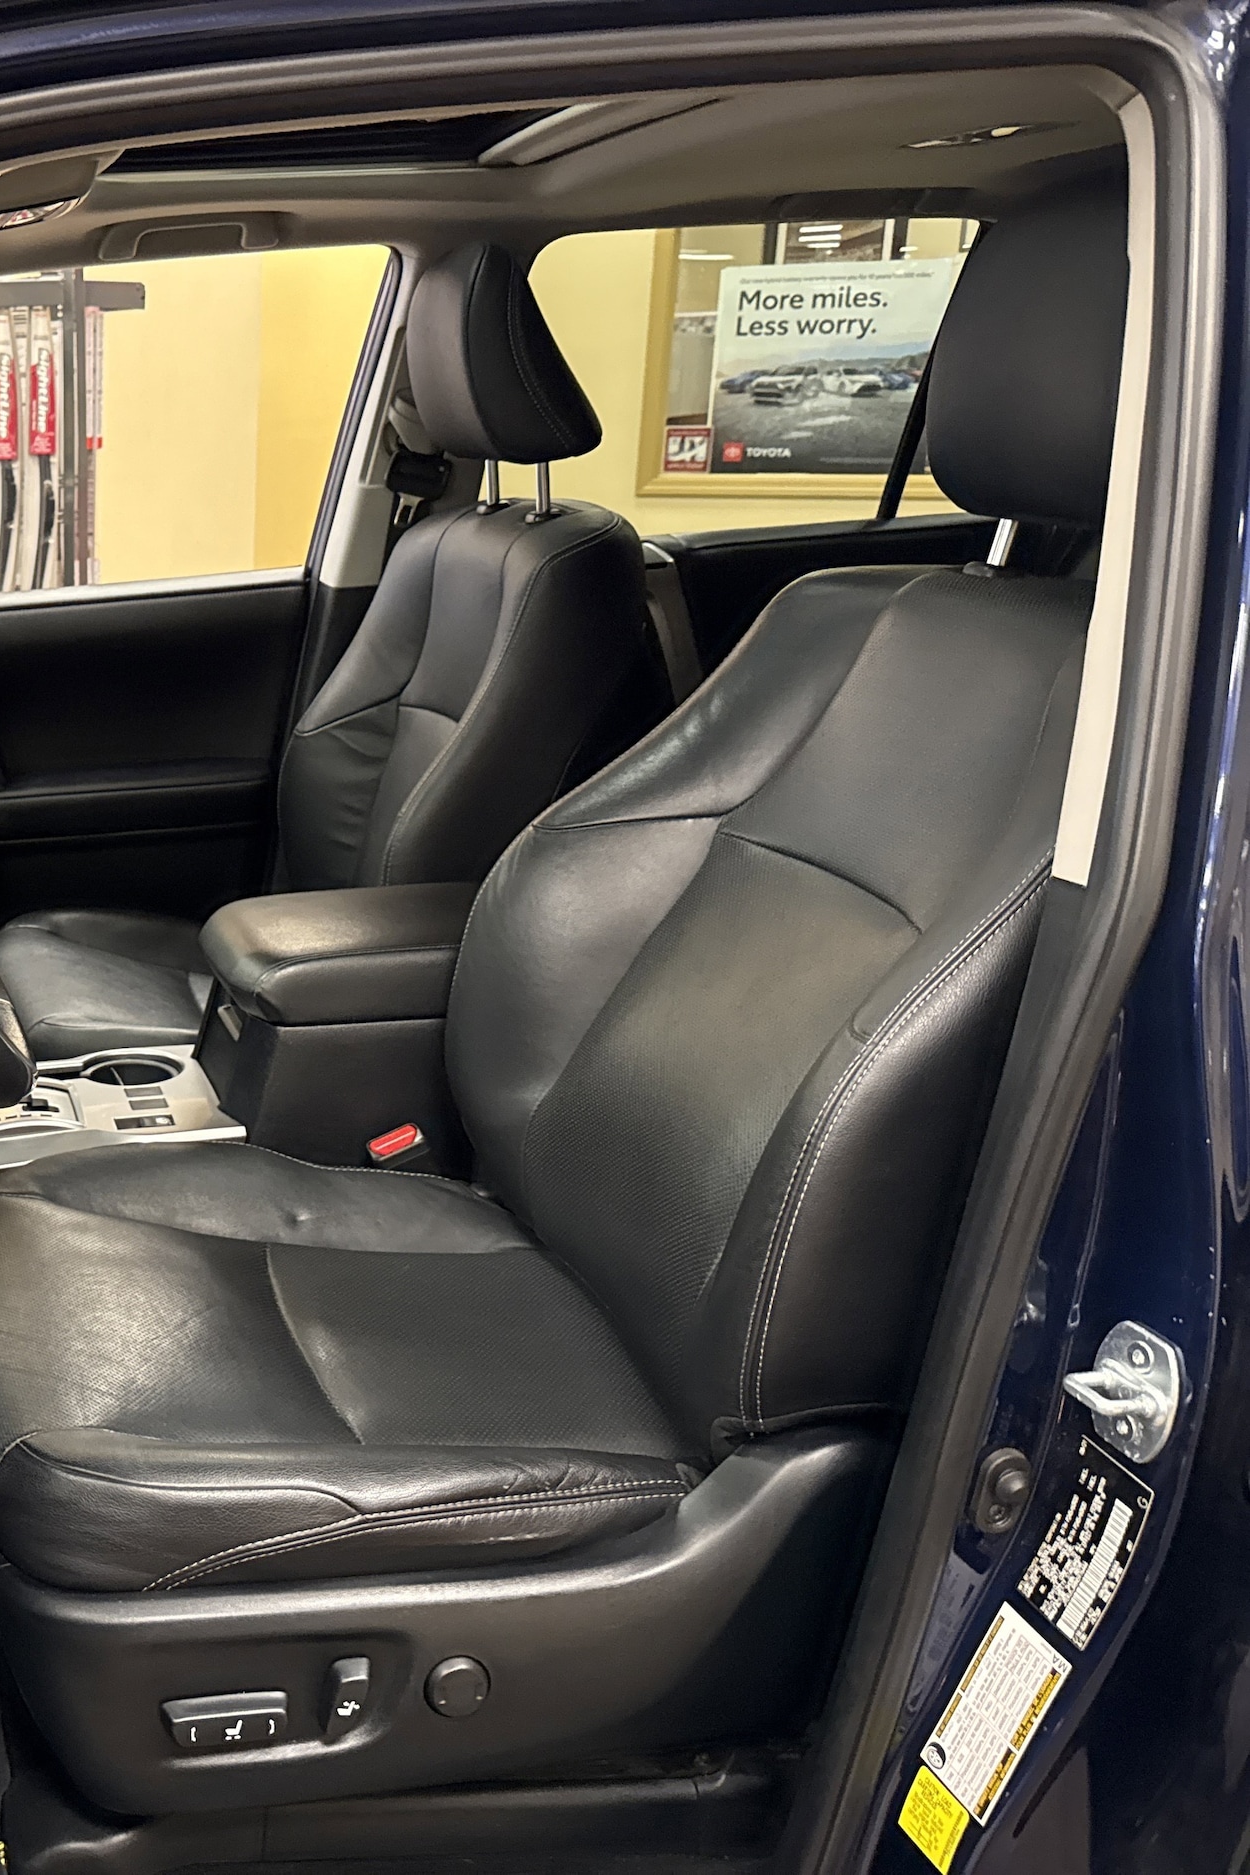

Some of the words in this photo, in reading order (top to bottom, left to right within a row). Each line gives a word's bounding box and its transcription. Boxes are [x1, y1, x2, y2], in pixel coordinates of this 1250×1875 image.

[738, 290, 804, 311] More
[811, 286, 889, 309] miles.
[736, 316, 789, 337] Less
[797, 317, 878, 339] worry.
[746, 447, 792, 459] TOYOTA
